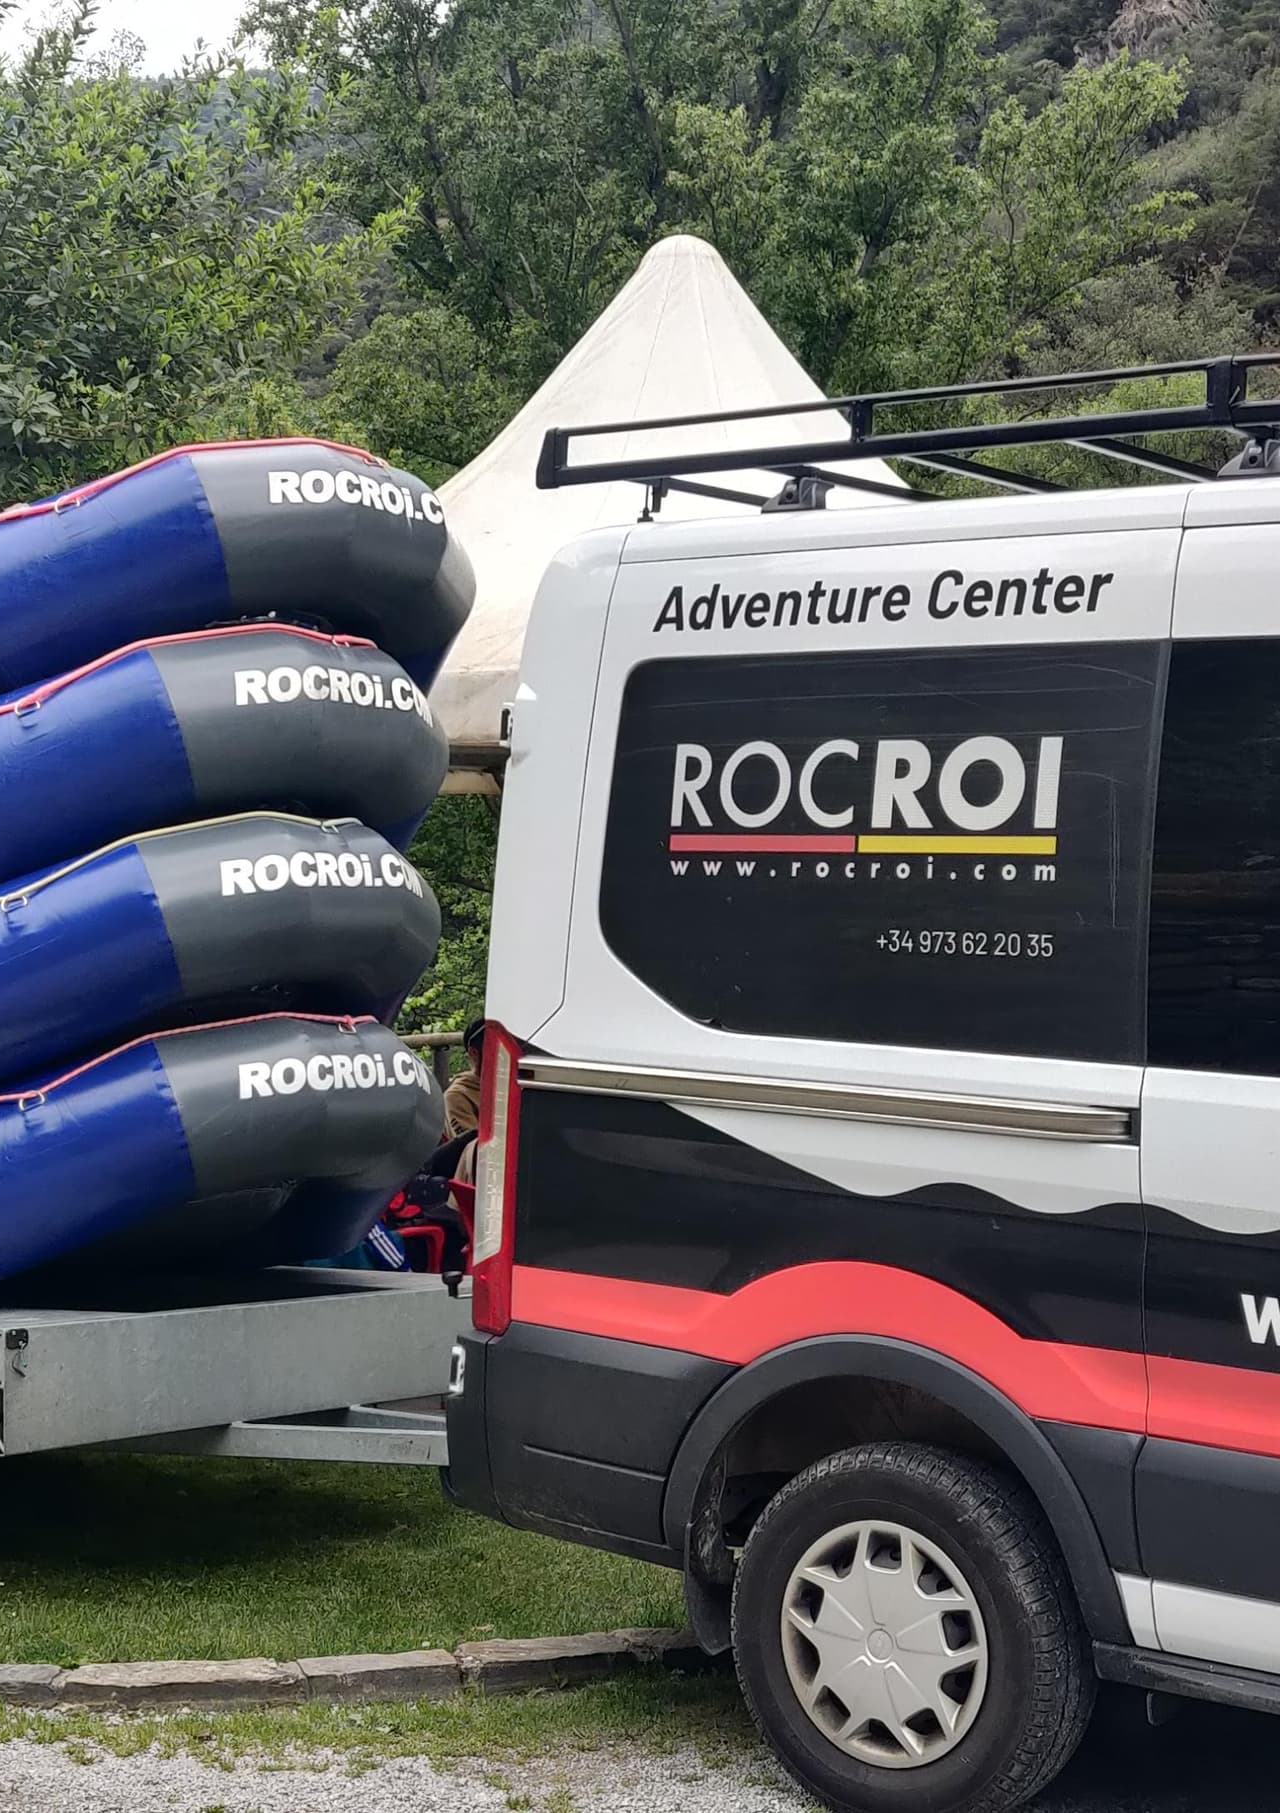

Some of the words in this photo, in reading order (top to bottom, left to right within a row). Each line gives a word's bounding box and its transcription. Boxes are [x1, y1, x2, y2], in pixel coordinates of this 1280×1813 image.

[652, 580, 911, 633] Adventure
[927, 568, 1113, 620] Center
[670, 736, 1064, 831] ROCROI
[670, 856, 1057, 882] www.rocroi.com
[876, 930, 913, 953] +34
[919, 930, 956, 954] 973
[962, 932, 988, 955] 62
[994, 933, 1020, 956] 20
[1027, 934, 1053, 957] 35
